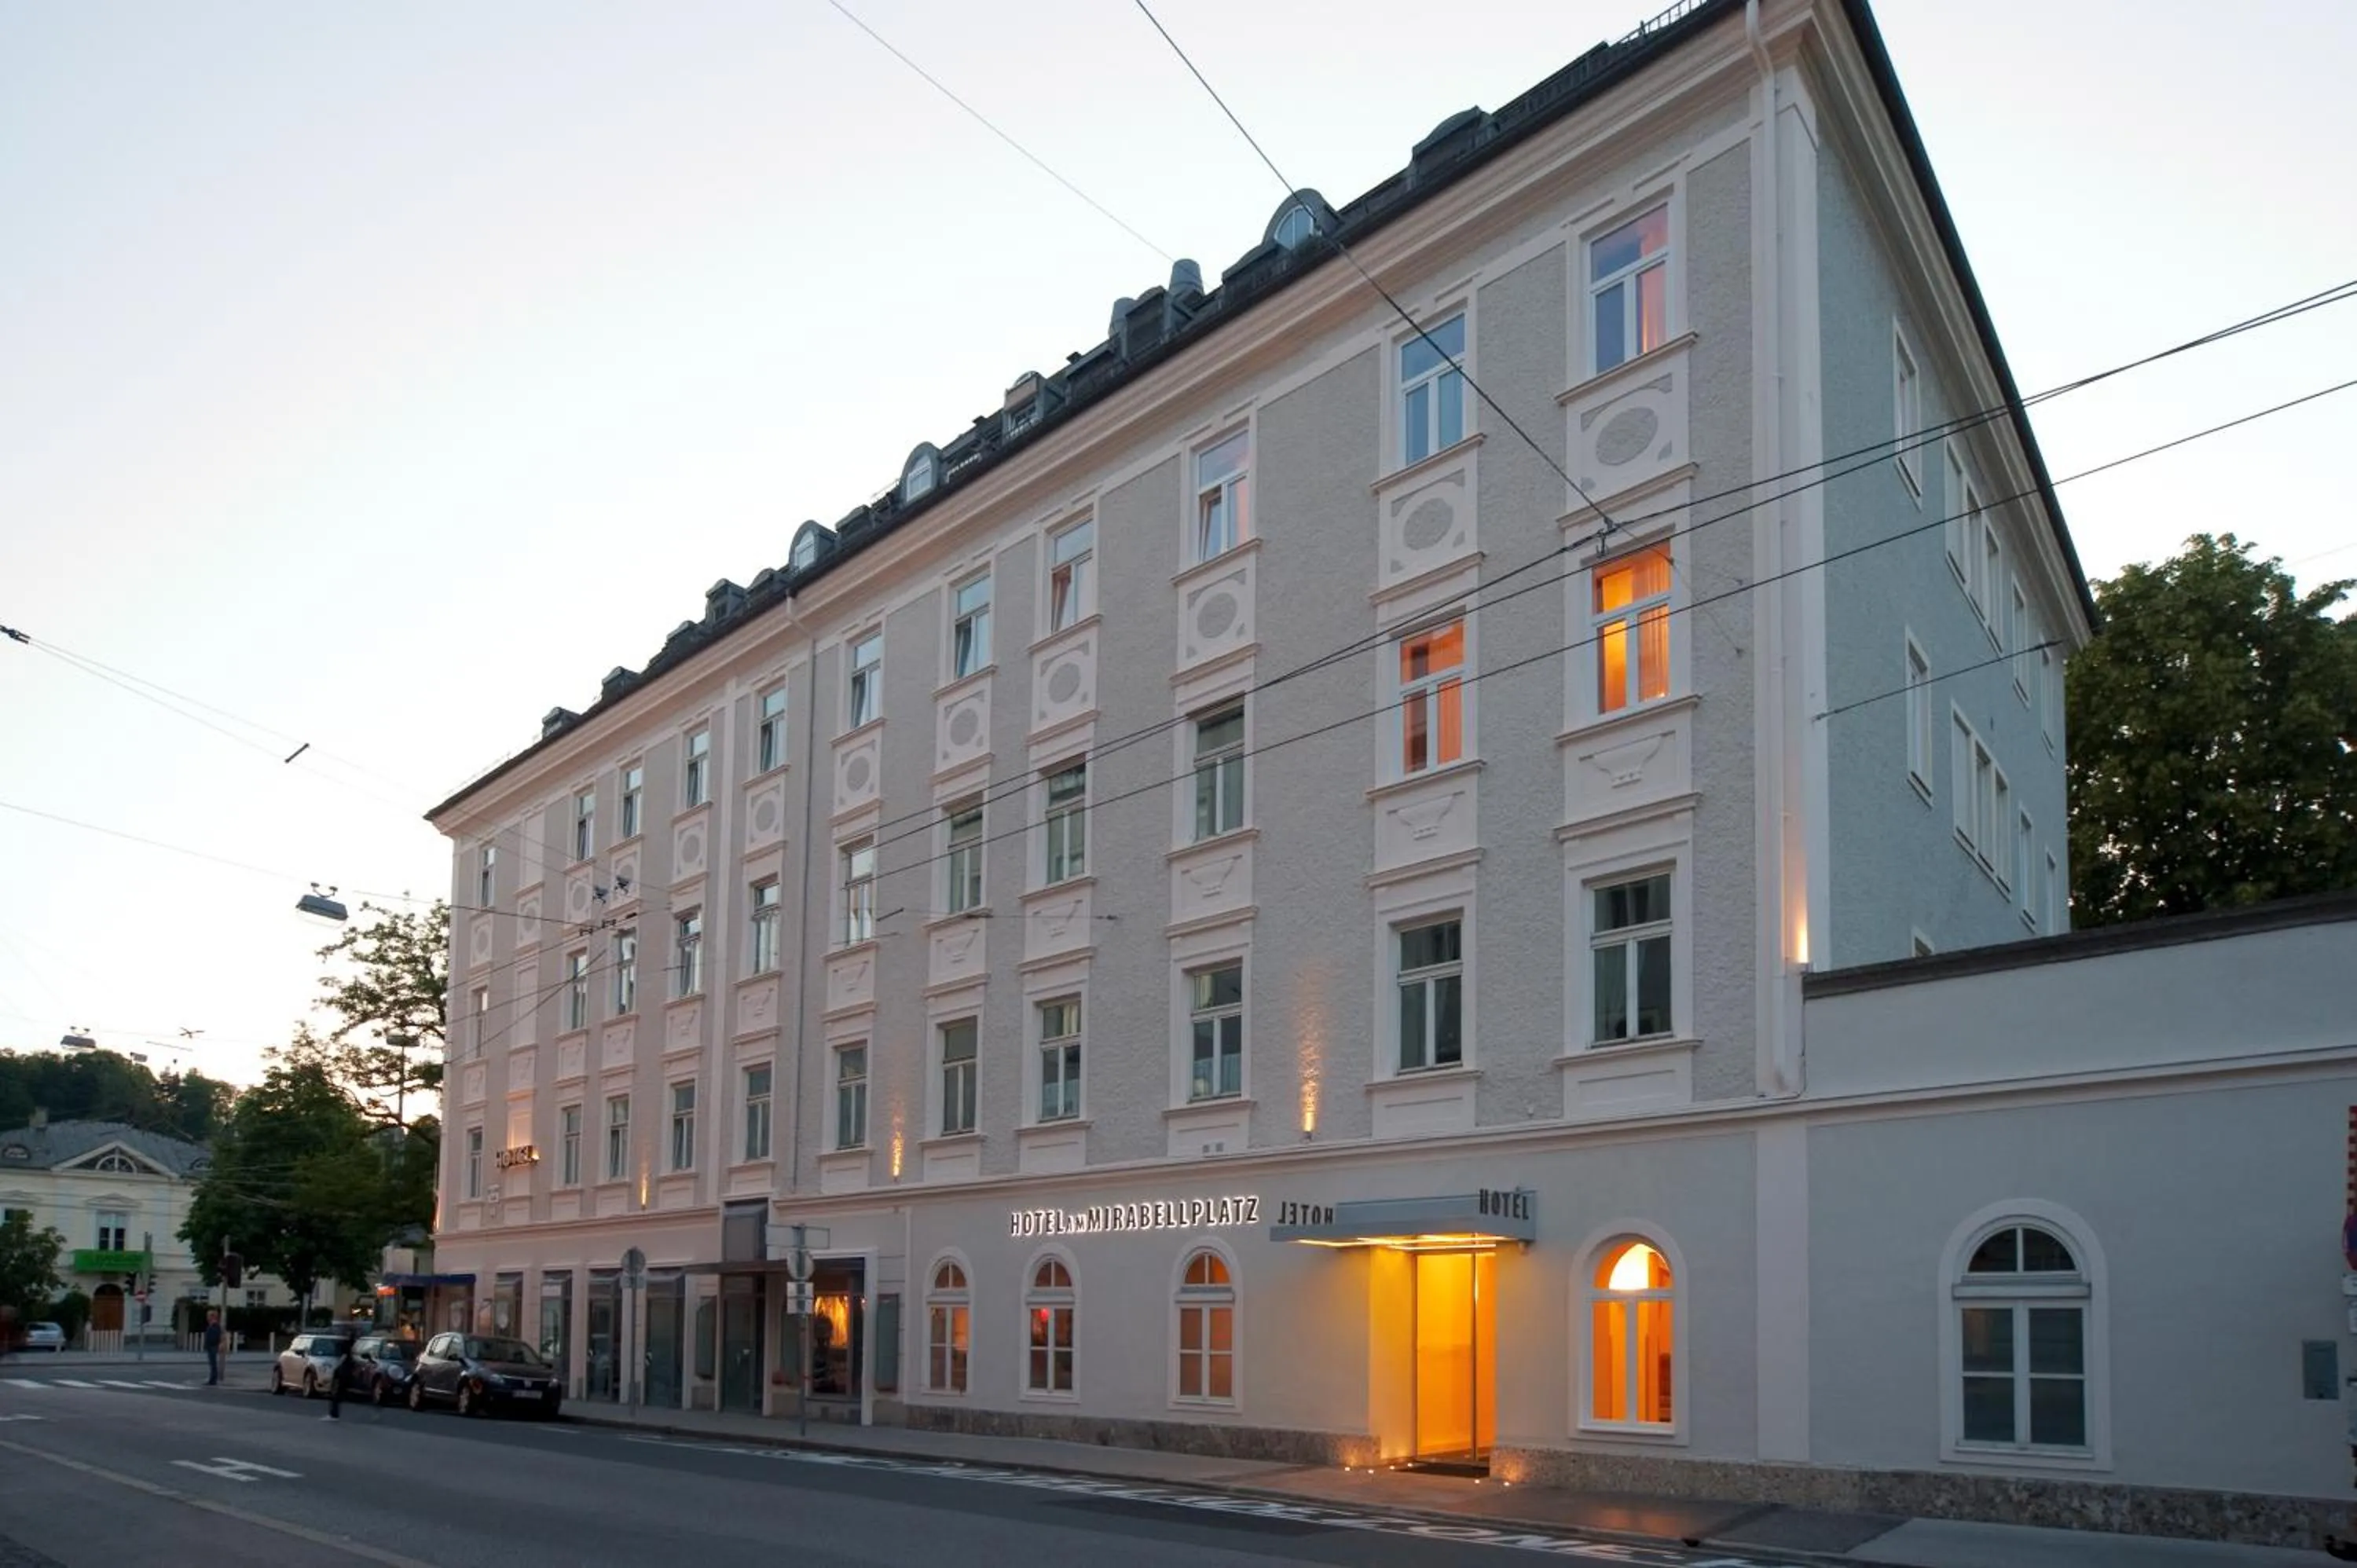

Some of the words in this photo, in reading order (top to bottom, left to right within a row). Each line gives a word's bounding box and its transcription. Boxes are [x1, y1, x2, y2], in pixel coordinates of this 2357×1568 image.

[1010, 1208, 1066, 1236] HOTEL
[1087, 1195, 1259, 1233] MIRABELLPLATZ
[1479, 1189, 1529, 1220] HOTEL
